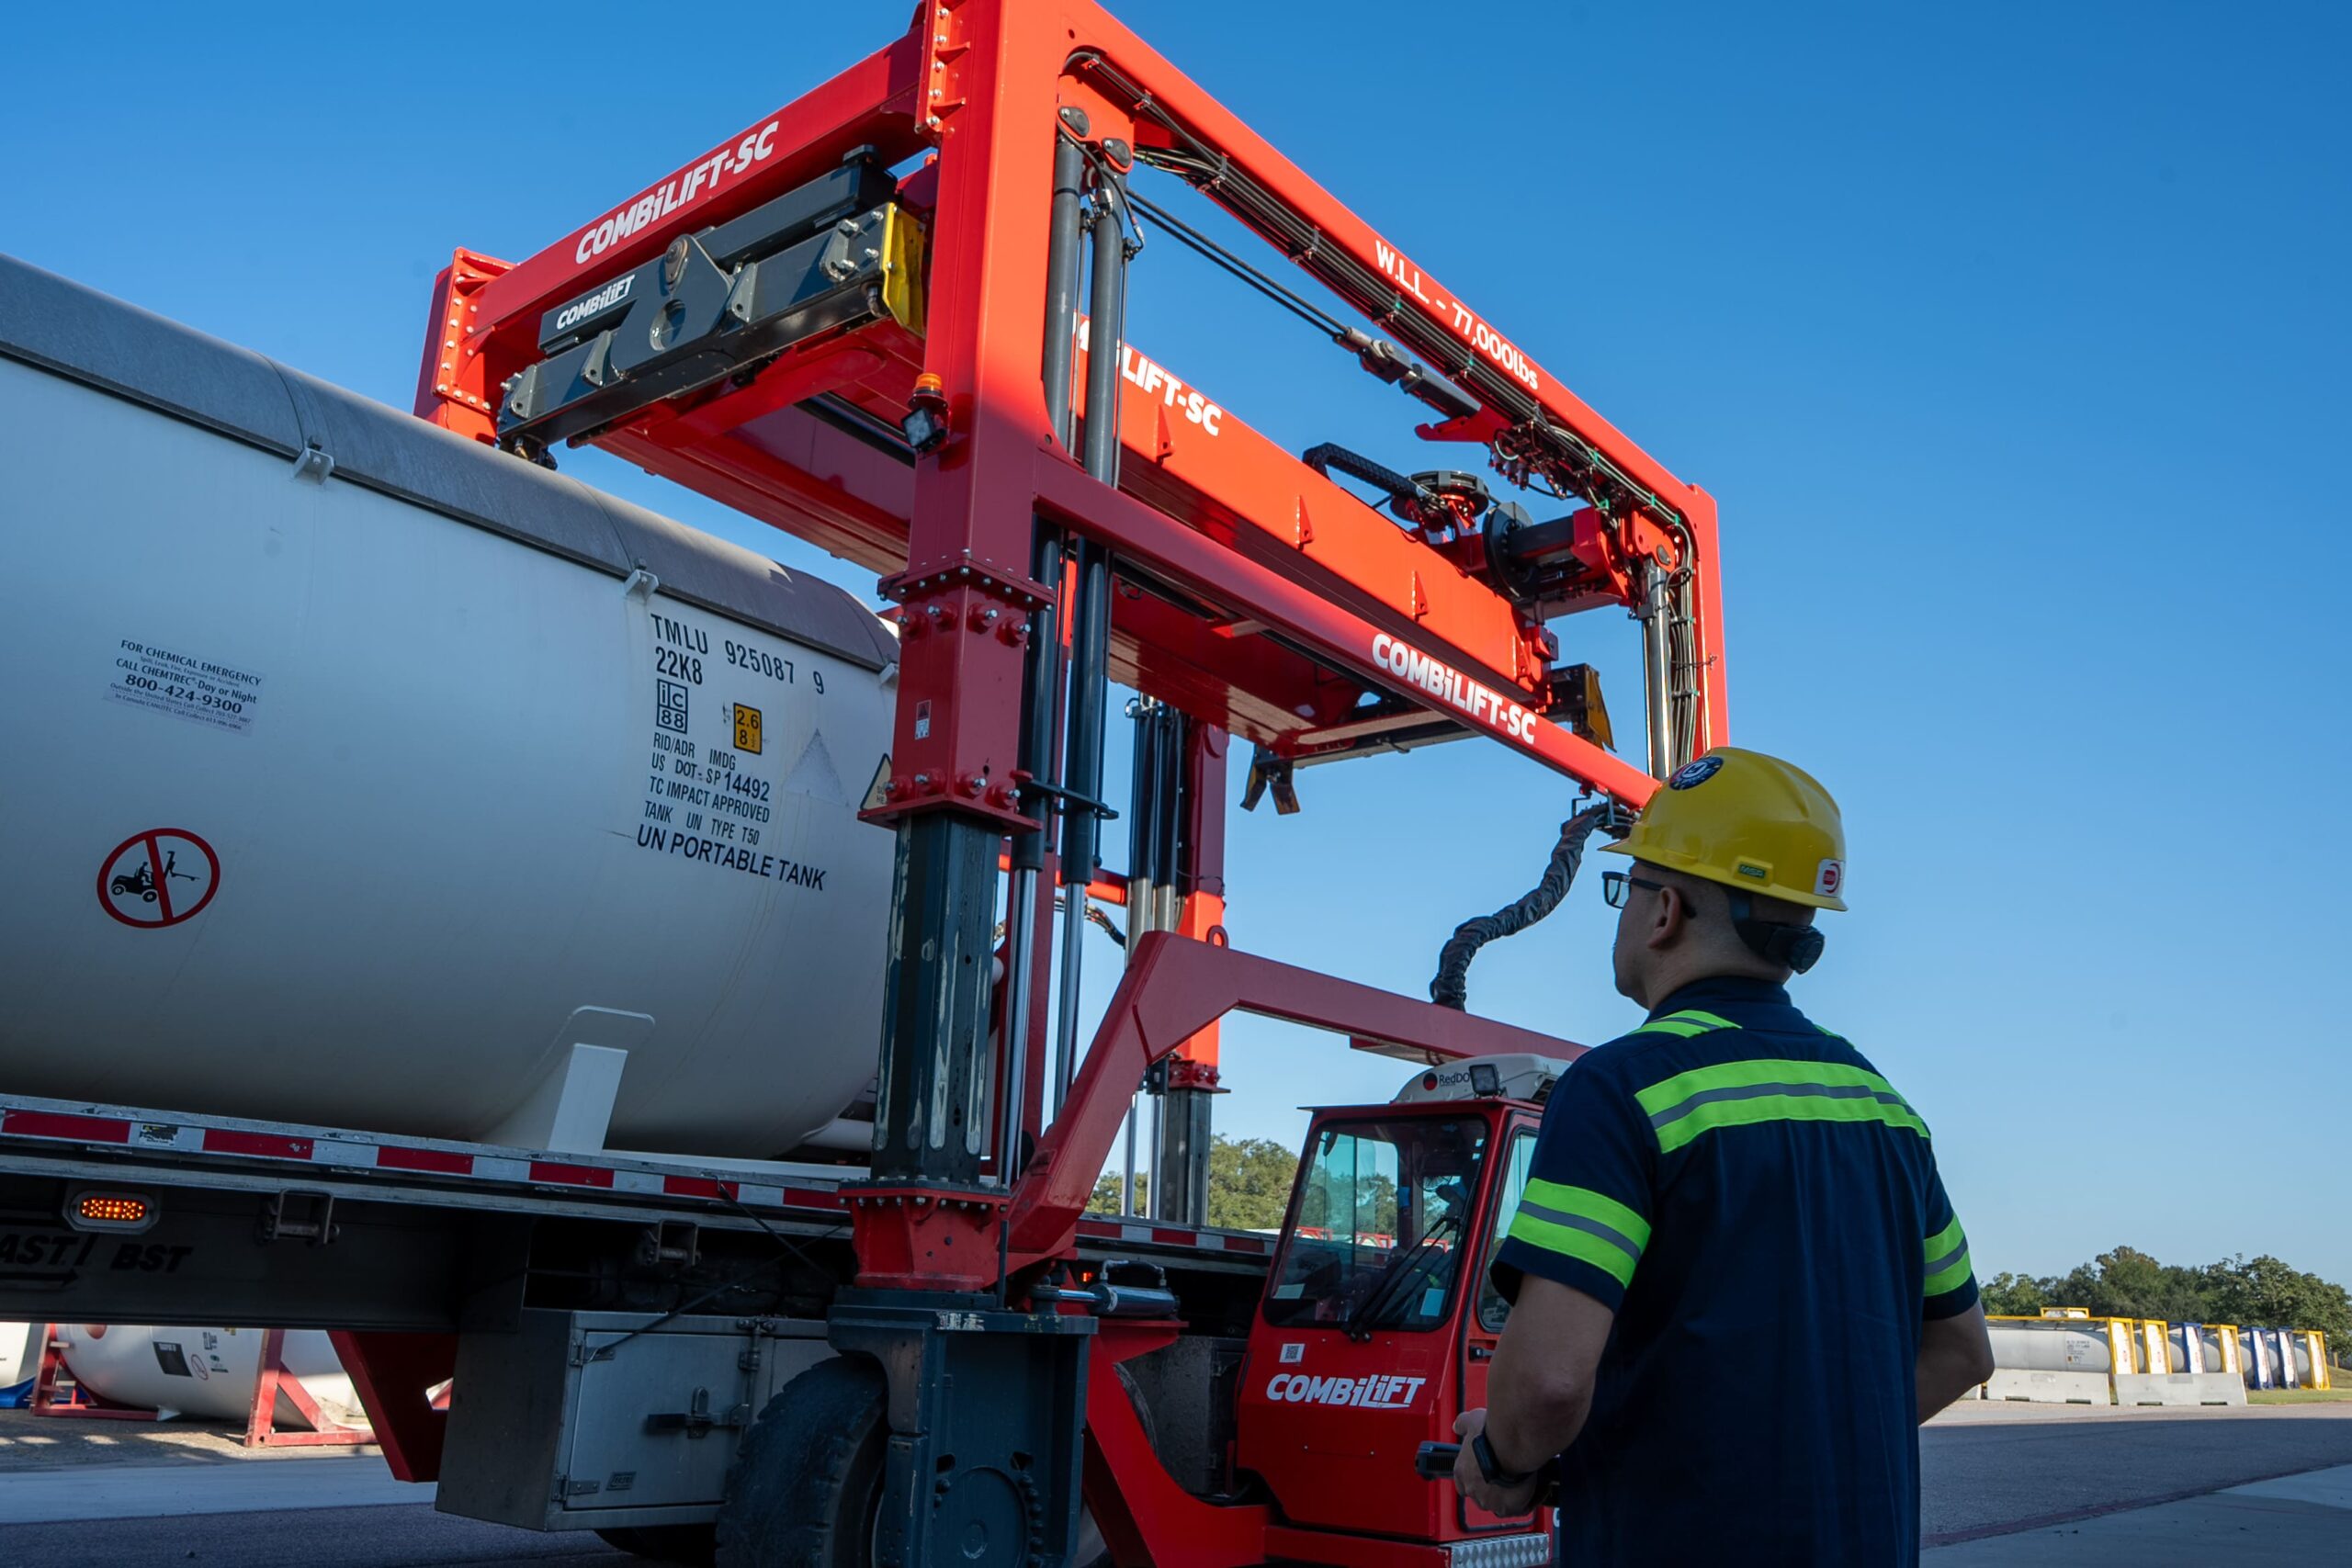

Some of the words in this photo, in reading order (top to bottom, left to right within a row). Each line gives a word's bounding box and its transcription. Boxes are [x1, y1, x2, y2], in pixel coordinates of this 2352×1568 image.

[1452, 301, 1539, 390] 77,000lbs
[120, 639, 143, 653] FOR
[145, 647, 198, 669] CHEMICAL
[201, 662, 262, 686] EMERGENCY
[650, 613, 708, 655] TMLU
[725, 639, 795, 684] 925087
[813, 671, 824, 694] 9
[656, 647, 703, 685] 22K8
[116, 658, 139, 671] CALL
[219, 688, 230, 696] or
[232, 691, 257, 704] Night
[125, 673, 243, 714] 800-424-9300
[662, 709, 684, 729] 88
[736, 709, 760, 730] 2.6
[739, 729, 748, 746] 8
[653, 732, 695, 759] RID/ADR
[709, 749, 736, 771] IMDG
[651, 752, 664, 772] US
[724, 771, 770, 802] 14492
[650, 776, 664, 795] TC
[666, 781, 708, 808] IMPACT
[712, 795, 770, 824] APPROVED
[645, 801, 673, 824] TANK
[686, 812, 702, 831] UN
[711, 818, 735, 840] TYPE
[742, 825, 760, 846] T50
[637, 824, 667, 852] UN
[670, 831, 774, 877] PORTABLE
[779, 859, 827, 891] TANK
[1439, 1072, 1470, 1085] RedDO
[109, 1243, 194, 1273] BST
